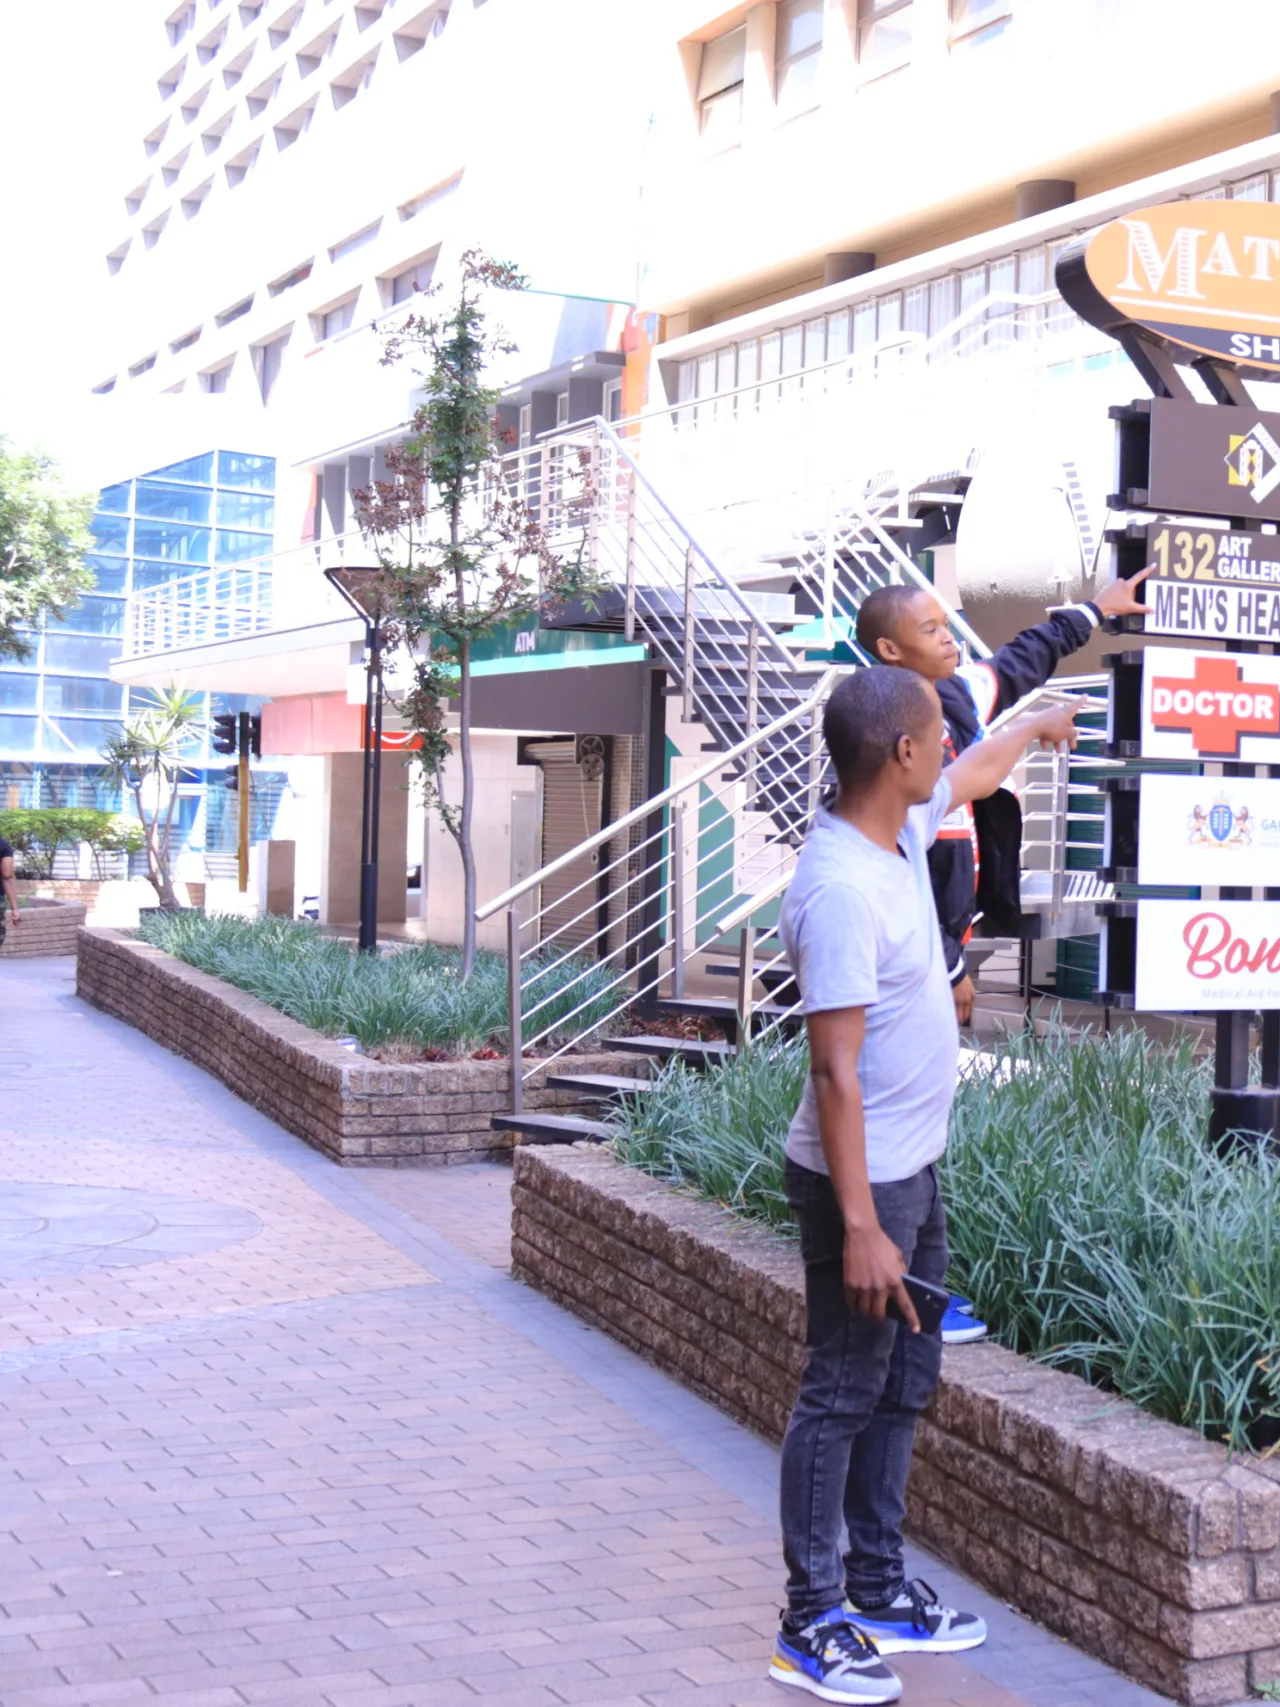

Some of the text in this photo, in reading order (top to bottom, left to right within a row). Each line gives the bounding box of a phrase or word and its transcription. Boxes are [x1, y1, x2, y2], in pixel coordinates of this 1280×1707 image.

[1152, 529, 1252, 580] 132 ART
[1155, 584, 1229, 632] MEN'S
[515, 631, 536, 653] ATM
[1152, 688, 1275, 720] DOCTOR
[1201, 988, 1244, 999] Medical
[1247, 988, 1264, 998] Aid
